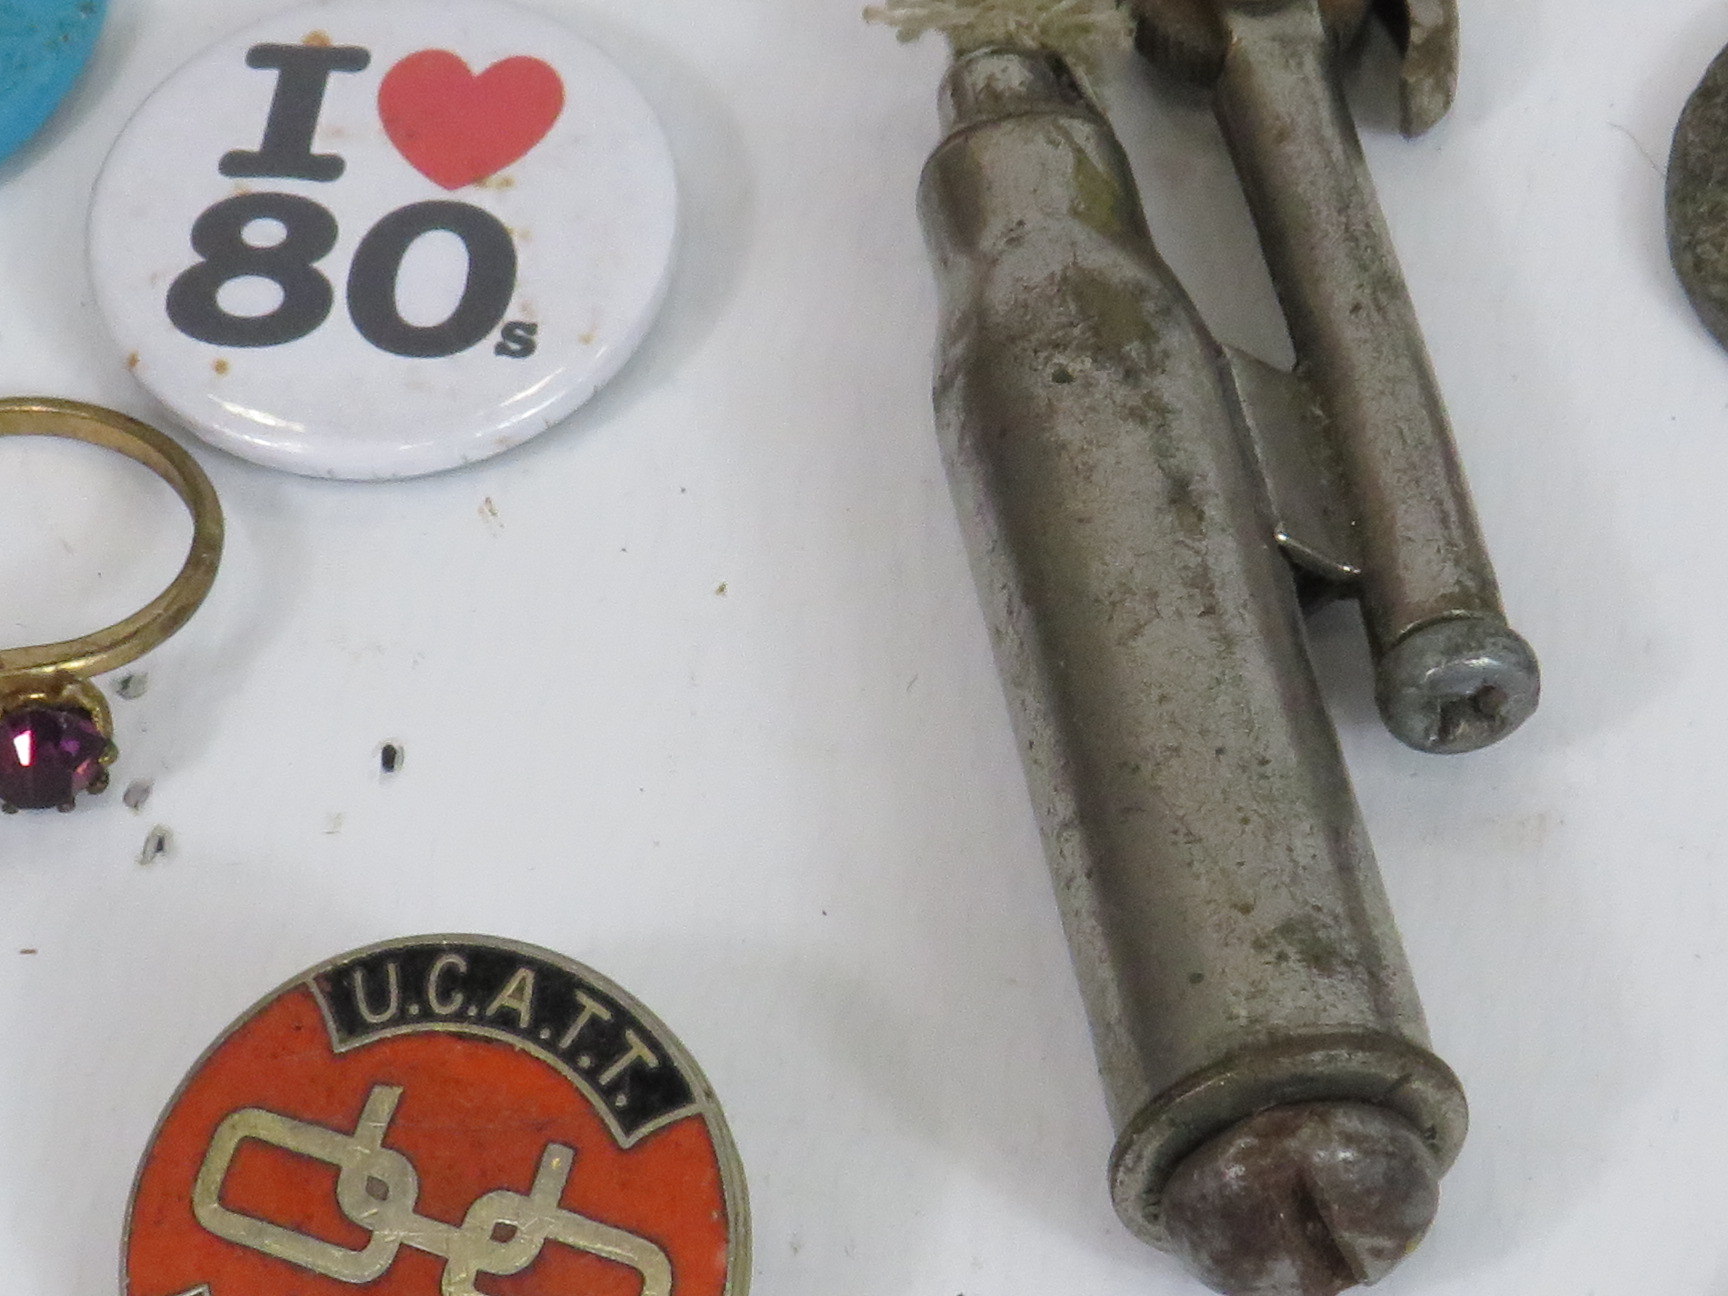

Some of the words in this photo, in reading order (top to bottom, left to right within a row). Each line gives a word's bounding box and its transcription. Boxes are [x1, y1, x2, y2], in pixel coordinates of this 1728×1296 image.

[218, 42, 372, 183] I
[165, 191, 539, 360] 80s
[351, 954, 661, 1108] U.C.A.T.T.
